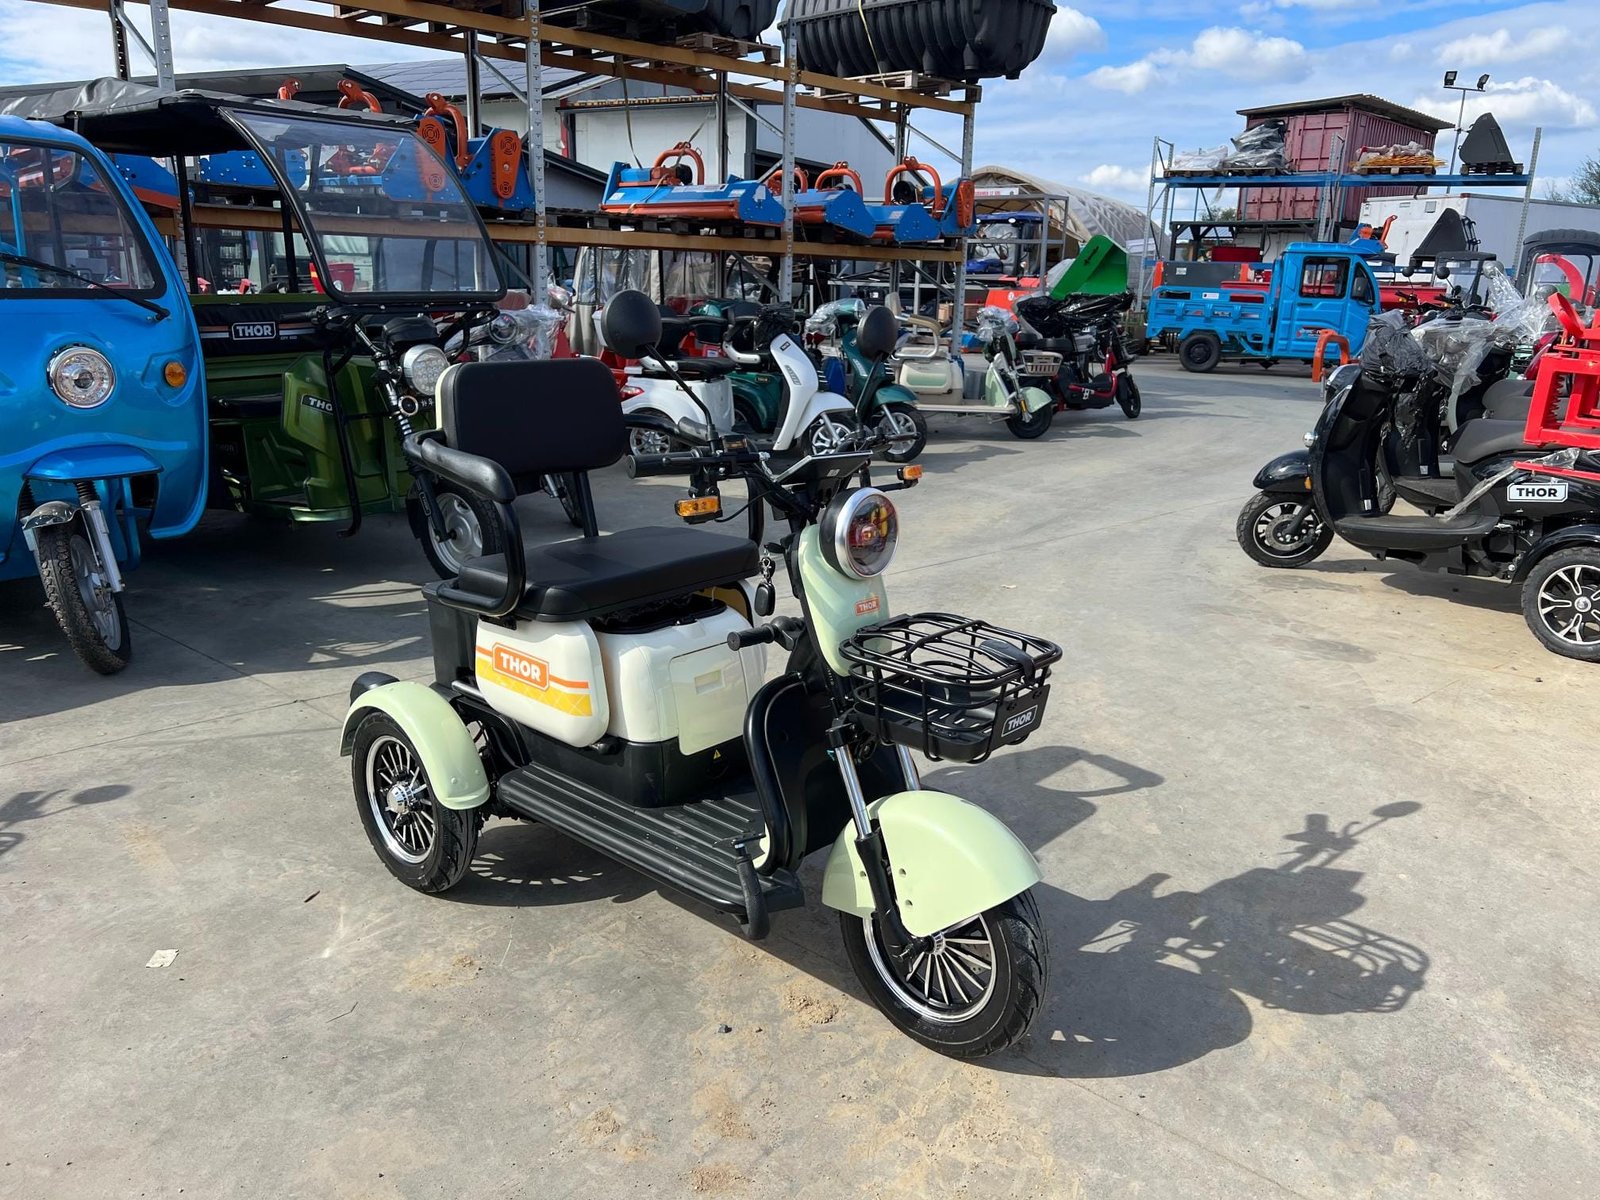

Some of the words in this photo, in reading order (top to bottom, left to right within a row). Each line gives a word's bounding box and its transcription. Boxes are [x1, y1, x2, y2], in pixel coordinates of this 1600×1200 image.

[236, 324, 273, 337] THOR
[309, 396, 333, 411] THO
[1516, 487, 1558, 497] THOR
[859, 600, 877, 611] THOR
[500, 652, 541, 682] THOR
[1008, 711, 1033, 730] THOR
